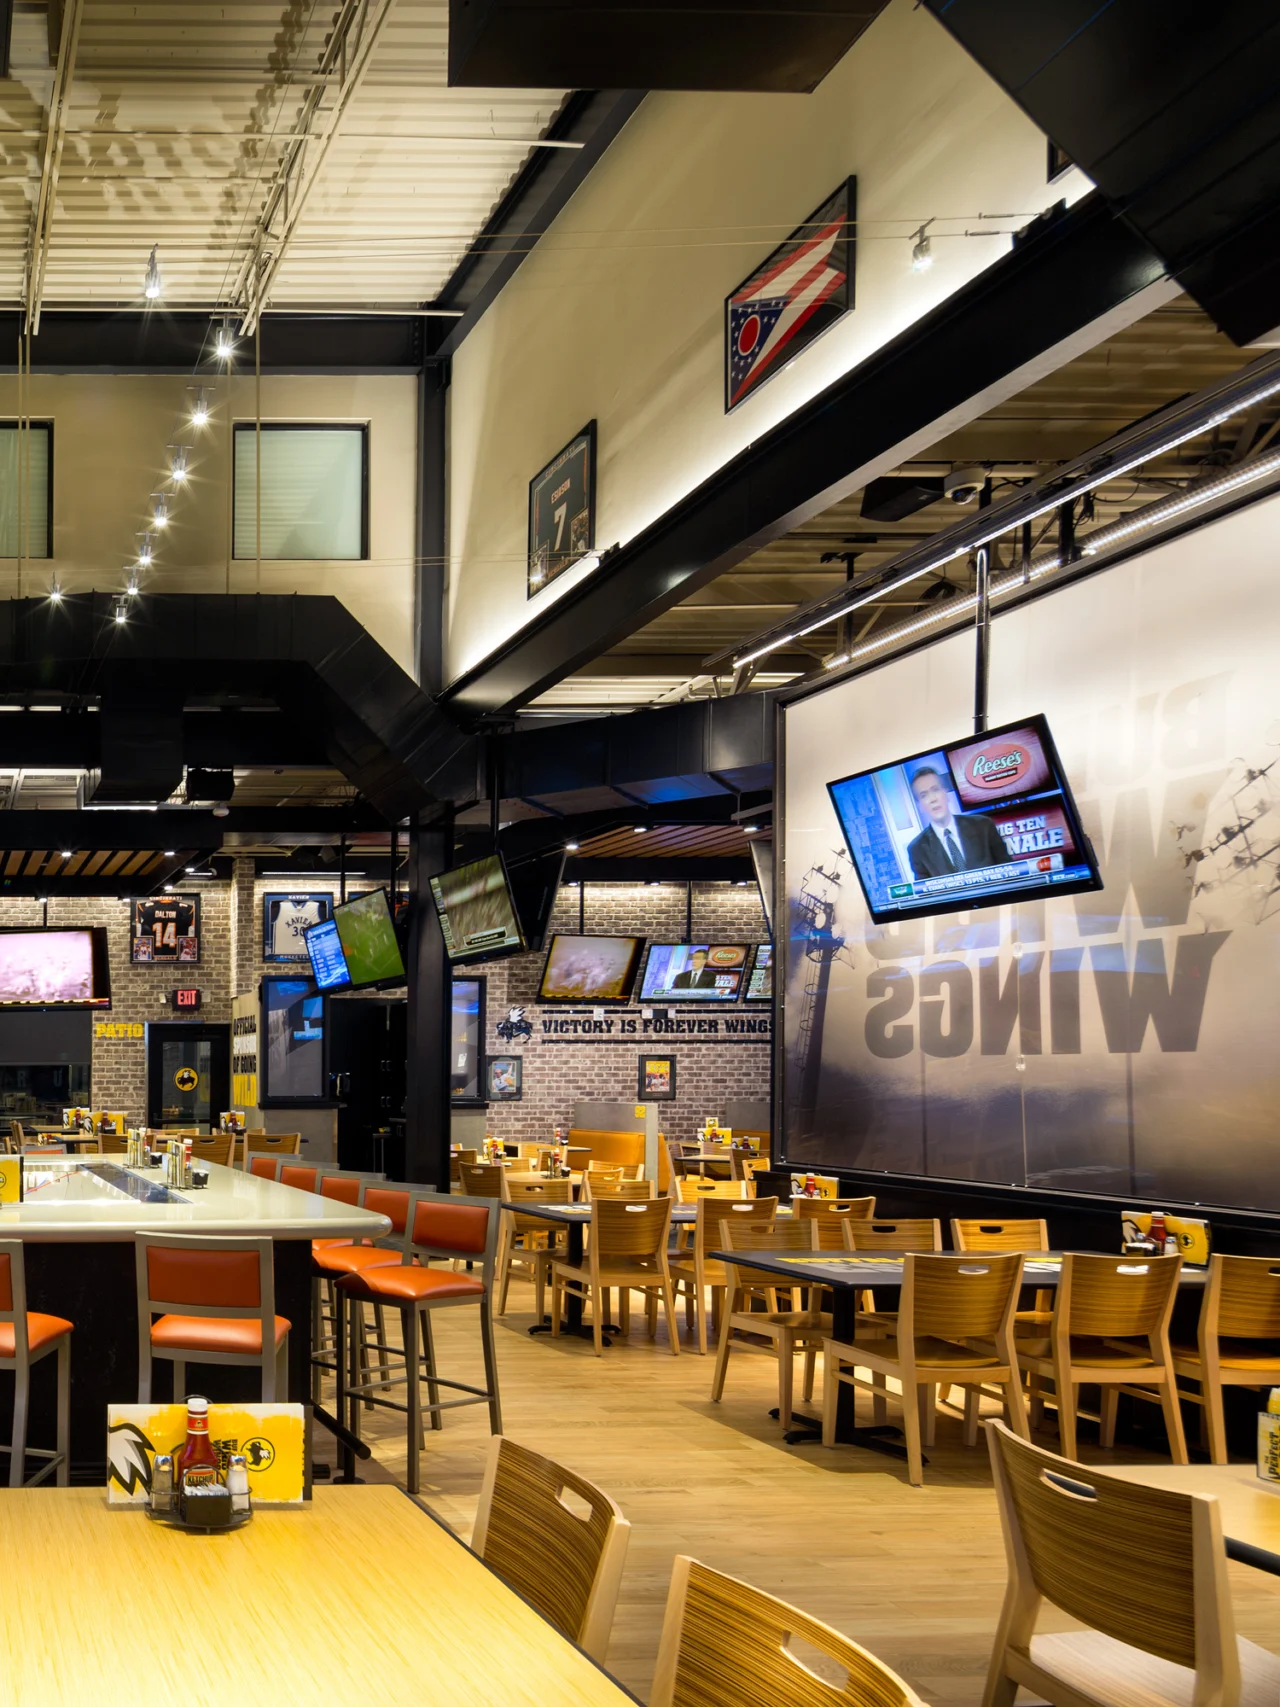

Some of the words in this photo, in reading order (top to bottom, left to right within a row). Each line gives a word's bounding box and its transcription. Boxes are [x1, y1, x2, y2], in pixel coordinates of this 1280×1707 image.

[554, 501, 567, 552] 7
[972, 750, 1024, 777] Reese's
[997, 822, 1014, 836] IG
[1016, 815, 1046, 833] TEN
[1003, 827, 1064, 856] NALE
[155, 910, 176, 918] DALTON
[152, 922, 177, 948] 14
[177, 990, 197, 1005] EXIT
[95, 1023, 143, 1038] PATIO
[233, 1014, 257, 1036] OFFICIAL
[542, 1019, 614, 1034] VICTORY
[620, 1019, 637, 1034] IS
[642, 1019, 719, 1034] FOREVER
[724, 1019, 771, 1034] WING
[233, 1055, 240, 1074] OF
[241, 1054, 257, 1073] GOING
[233, 1074, 257, 1107] WILD
[1268, 1431, 1279, 1475] PERFECT
[187, 1474, 214, 1486] KETCHUP
